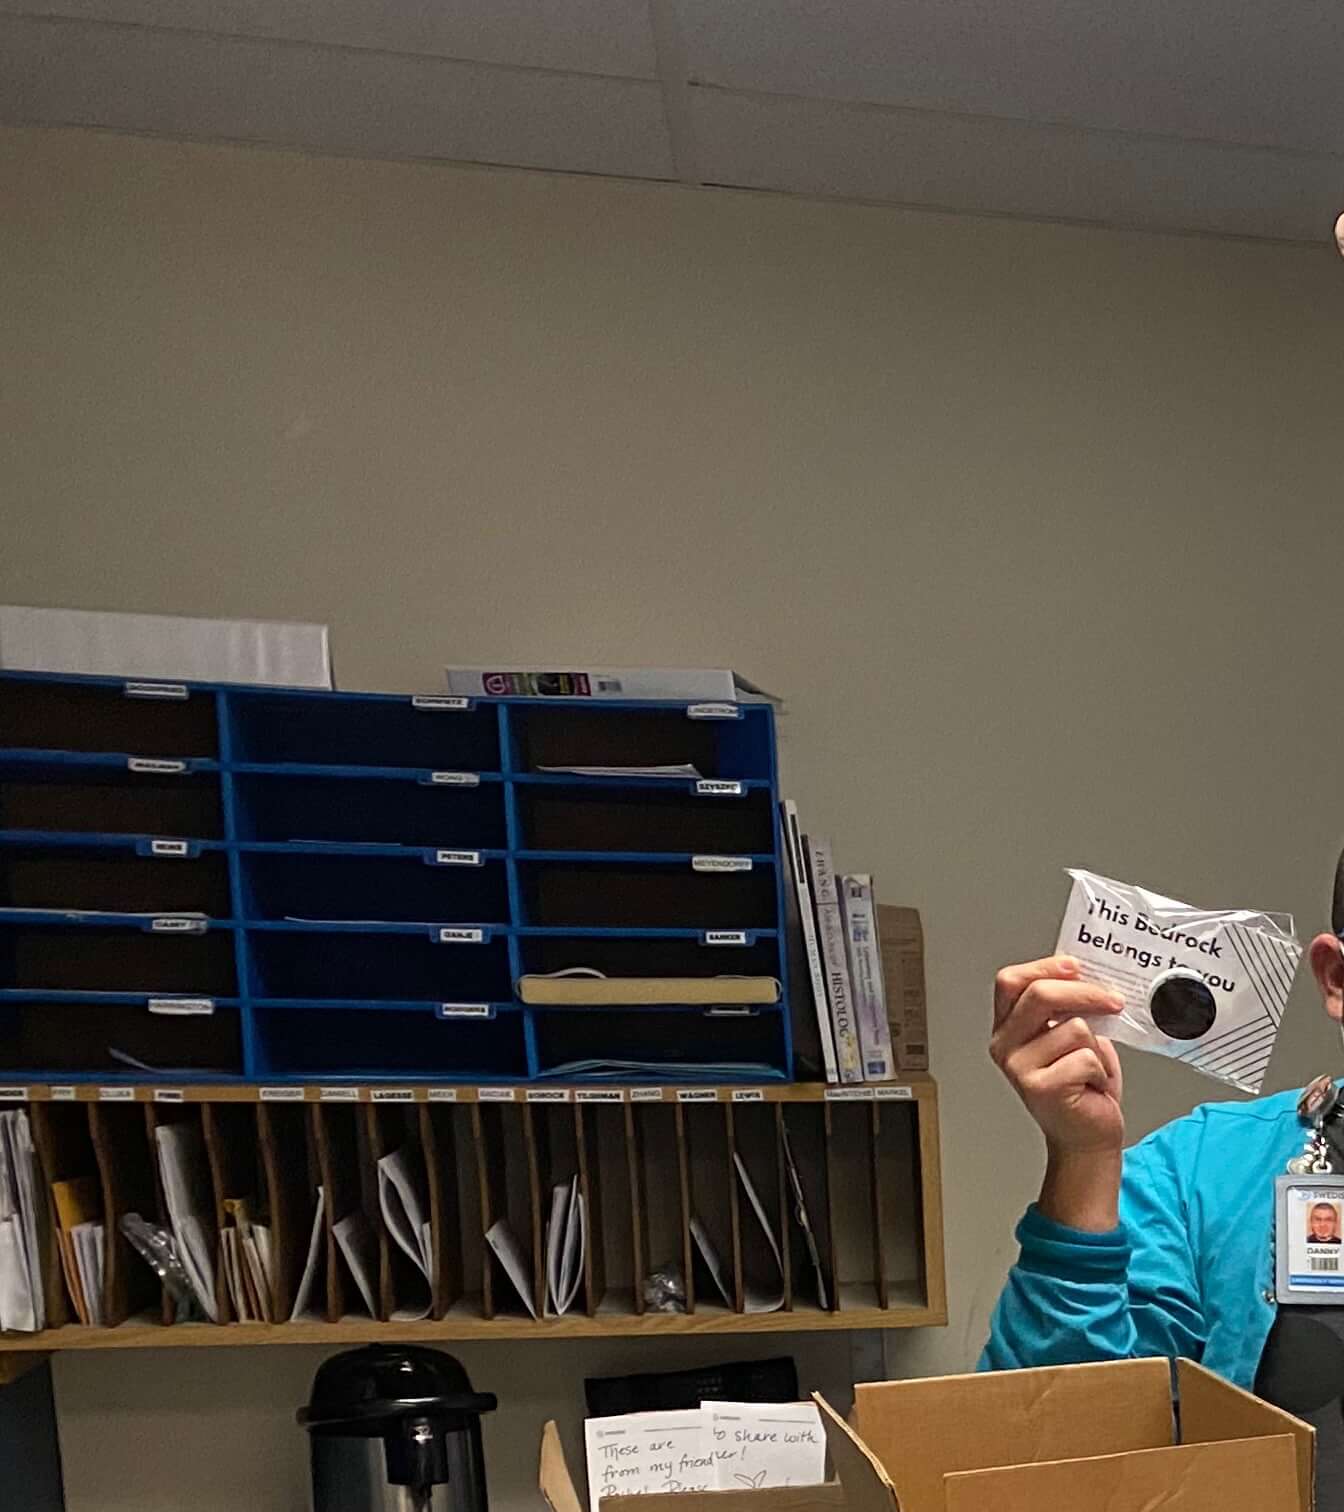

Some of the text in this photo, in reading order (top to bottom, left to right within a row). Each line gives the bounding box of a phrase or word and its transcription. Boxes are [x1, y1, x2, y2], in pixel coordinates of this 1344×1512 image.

[1076, 924, 1162, 969] belongs
[735, 1428, 778, 1443] share
[783, 1429, 820, 1444] with
[601, 1464, 640, 1484] from
[650, 1458, 674, 1478] my
